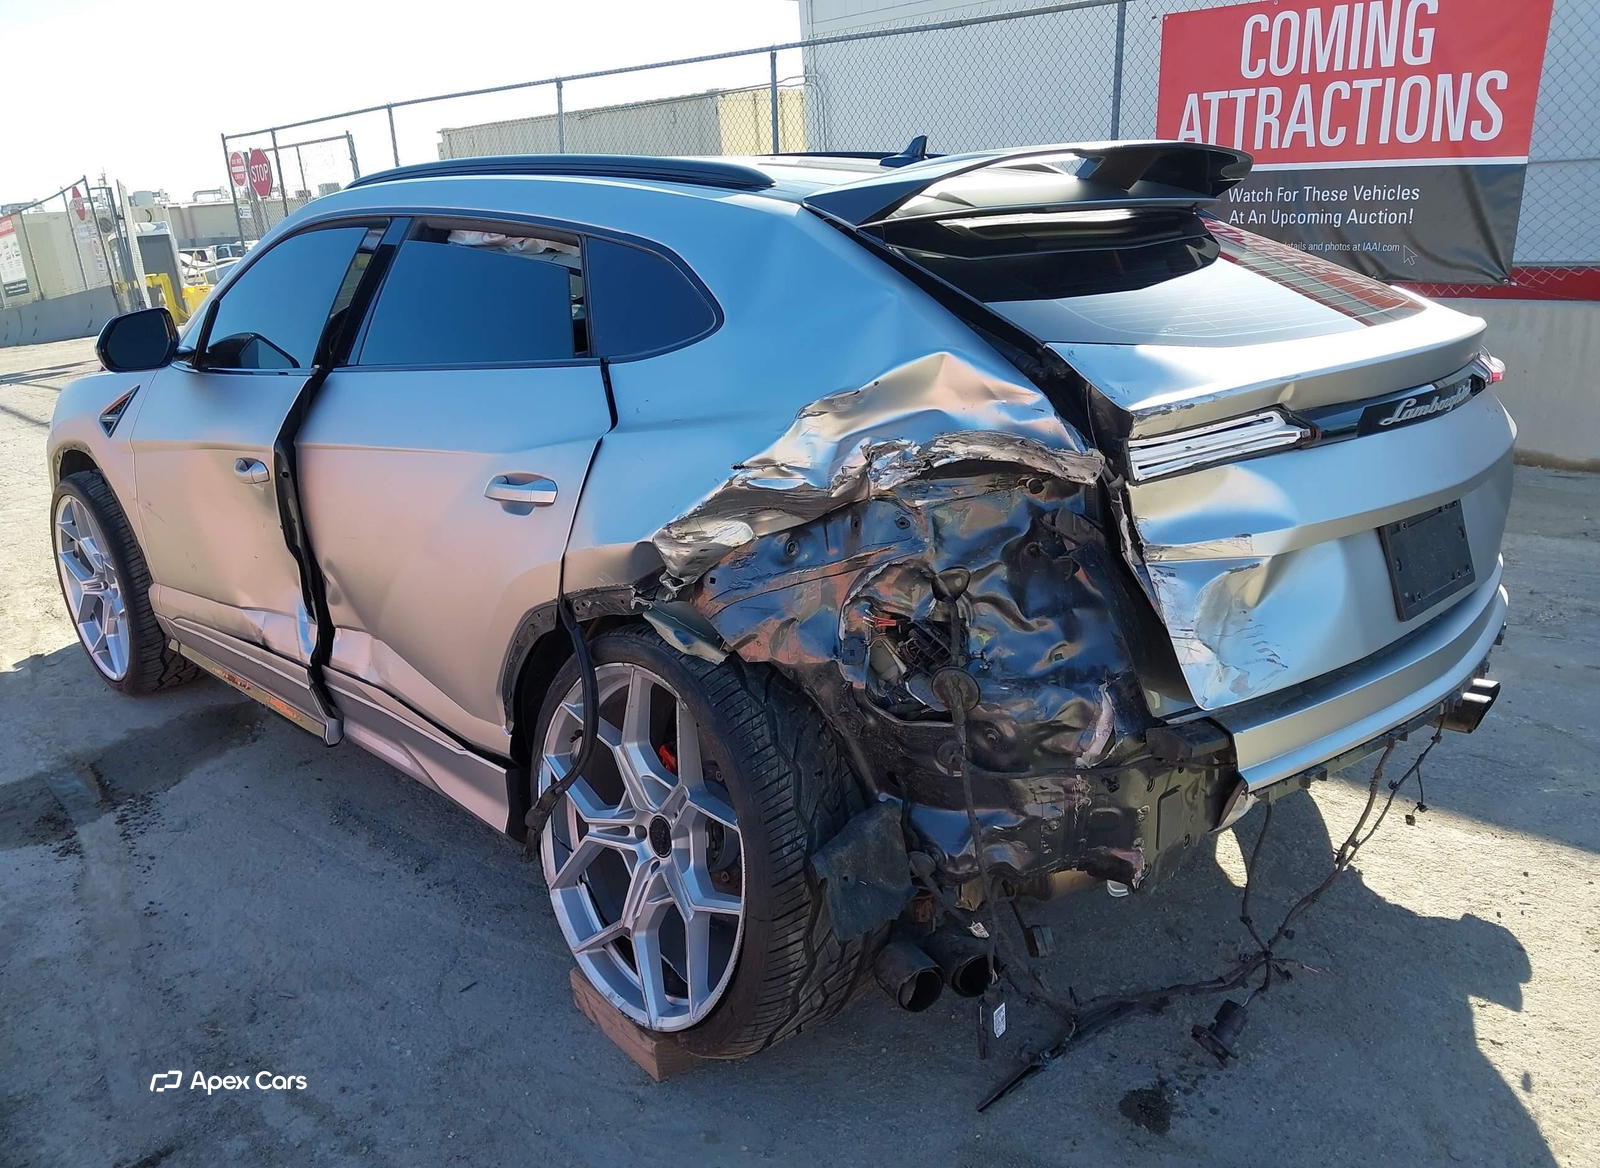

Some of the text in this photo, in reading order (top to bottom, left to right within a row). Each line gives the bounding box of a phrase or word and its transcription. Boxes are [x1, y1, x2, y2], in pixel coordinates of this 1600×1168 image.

[1240, 0, 1439, 79] COMING
[1177, 69, 1508, 150] ATTRACTIONS
[250, 163, 268, 183] STOP
[1228, 184, 1420, 203] Watch For These Vehicles
[1228, 208, 1414, 228] At An Upcoming Auction!
[1285, 241, 1400, 253] etails and photos at IAAI.com
